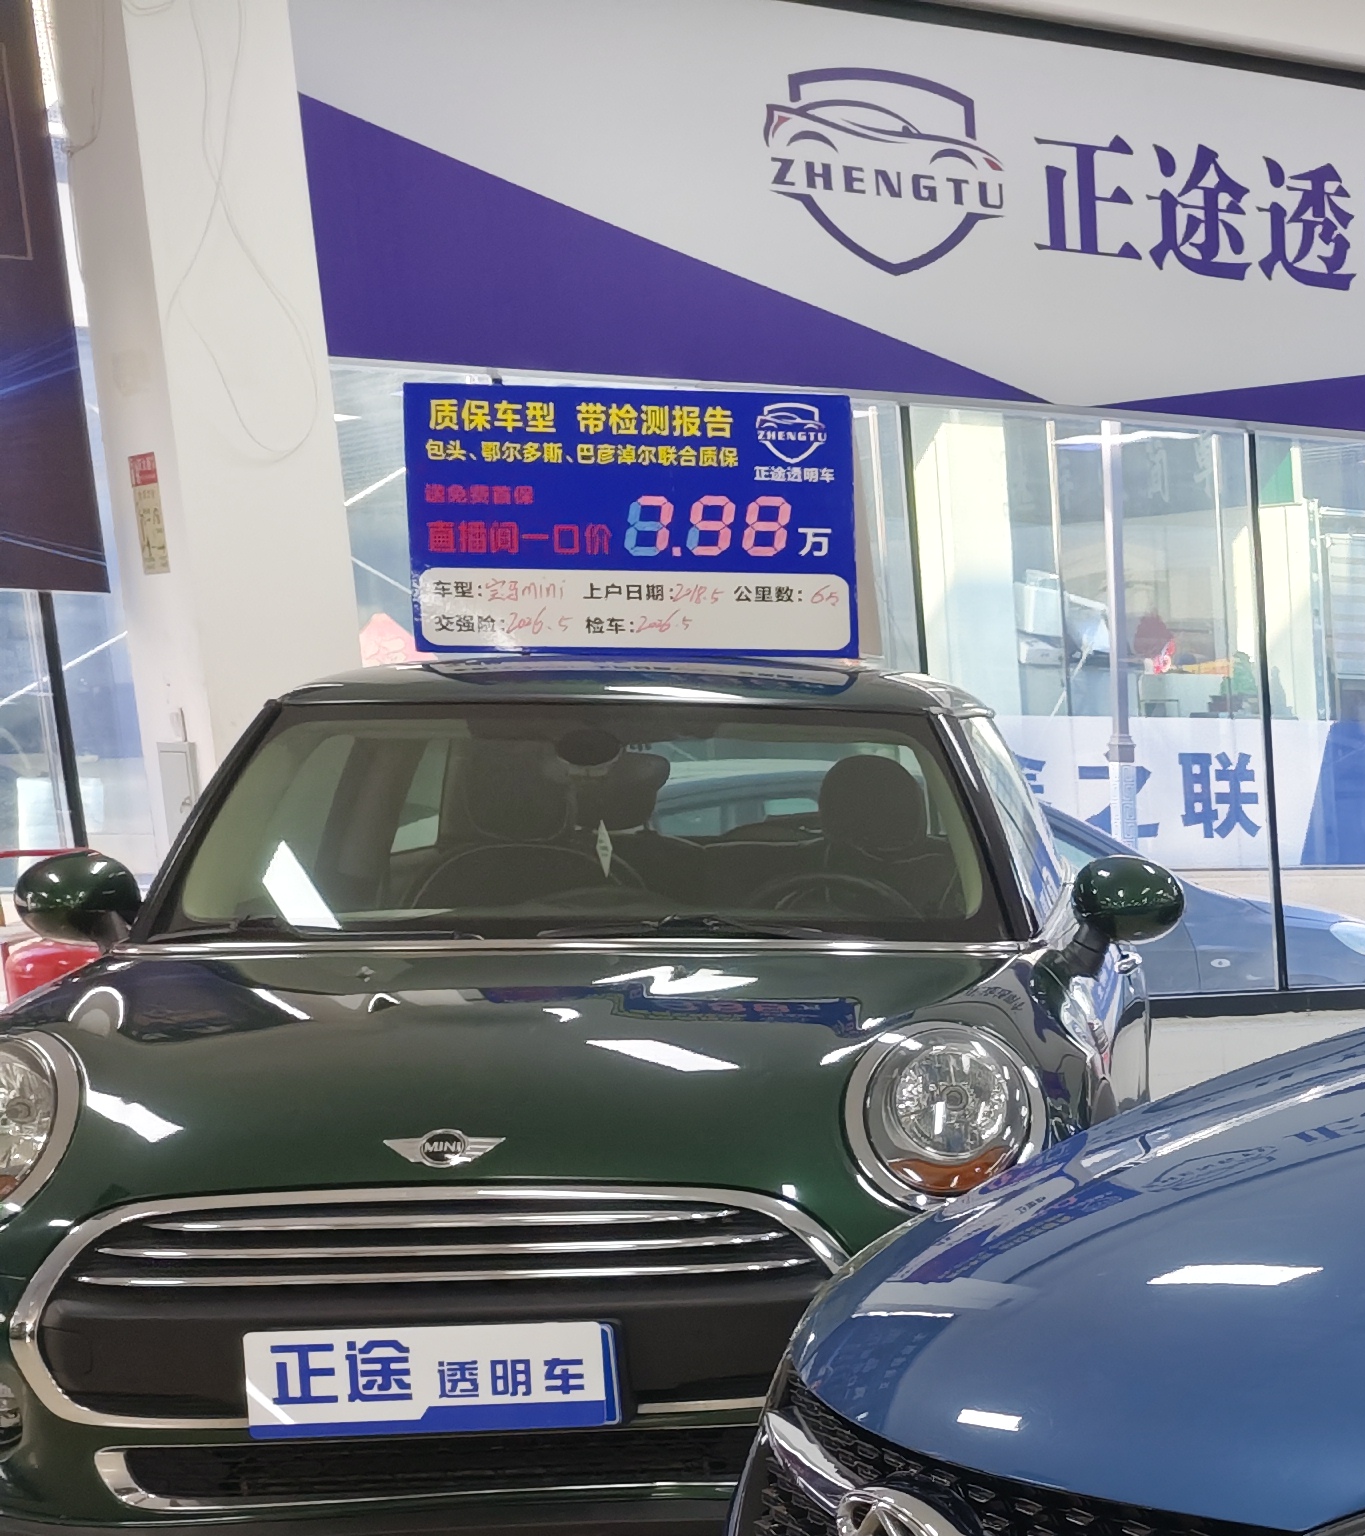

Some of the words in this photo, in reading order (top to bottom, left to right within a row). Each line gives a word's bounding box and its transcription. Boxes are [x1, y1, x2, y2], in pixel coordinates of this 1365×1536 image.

[770, 156, 1004, 211] ZHENGTU
[429, 398, 557, 434] 质保车型
[575, 402, 734, 439] 带检测报告
[757, 430, 828, 443] ZHENGTU
[797, 527, 832, 557] 万
[424, 1140, 462, 1154] MINI
[270, 1339, 413, 1405] 正途
[437, 1358, 586, 1398] 透明车
